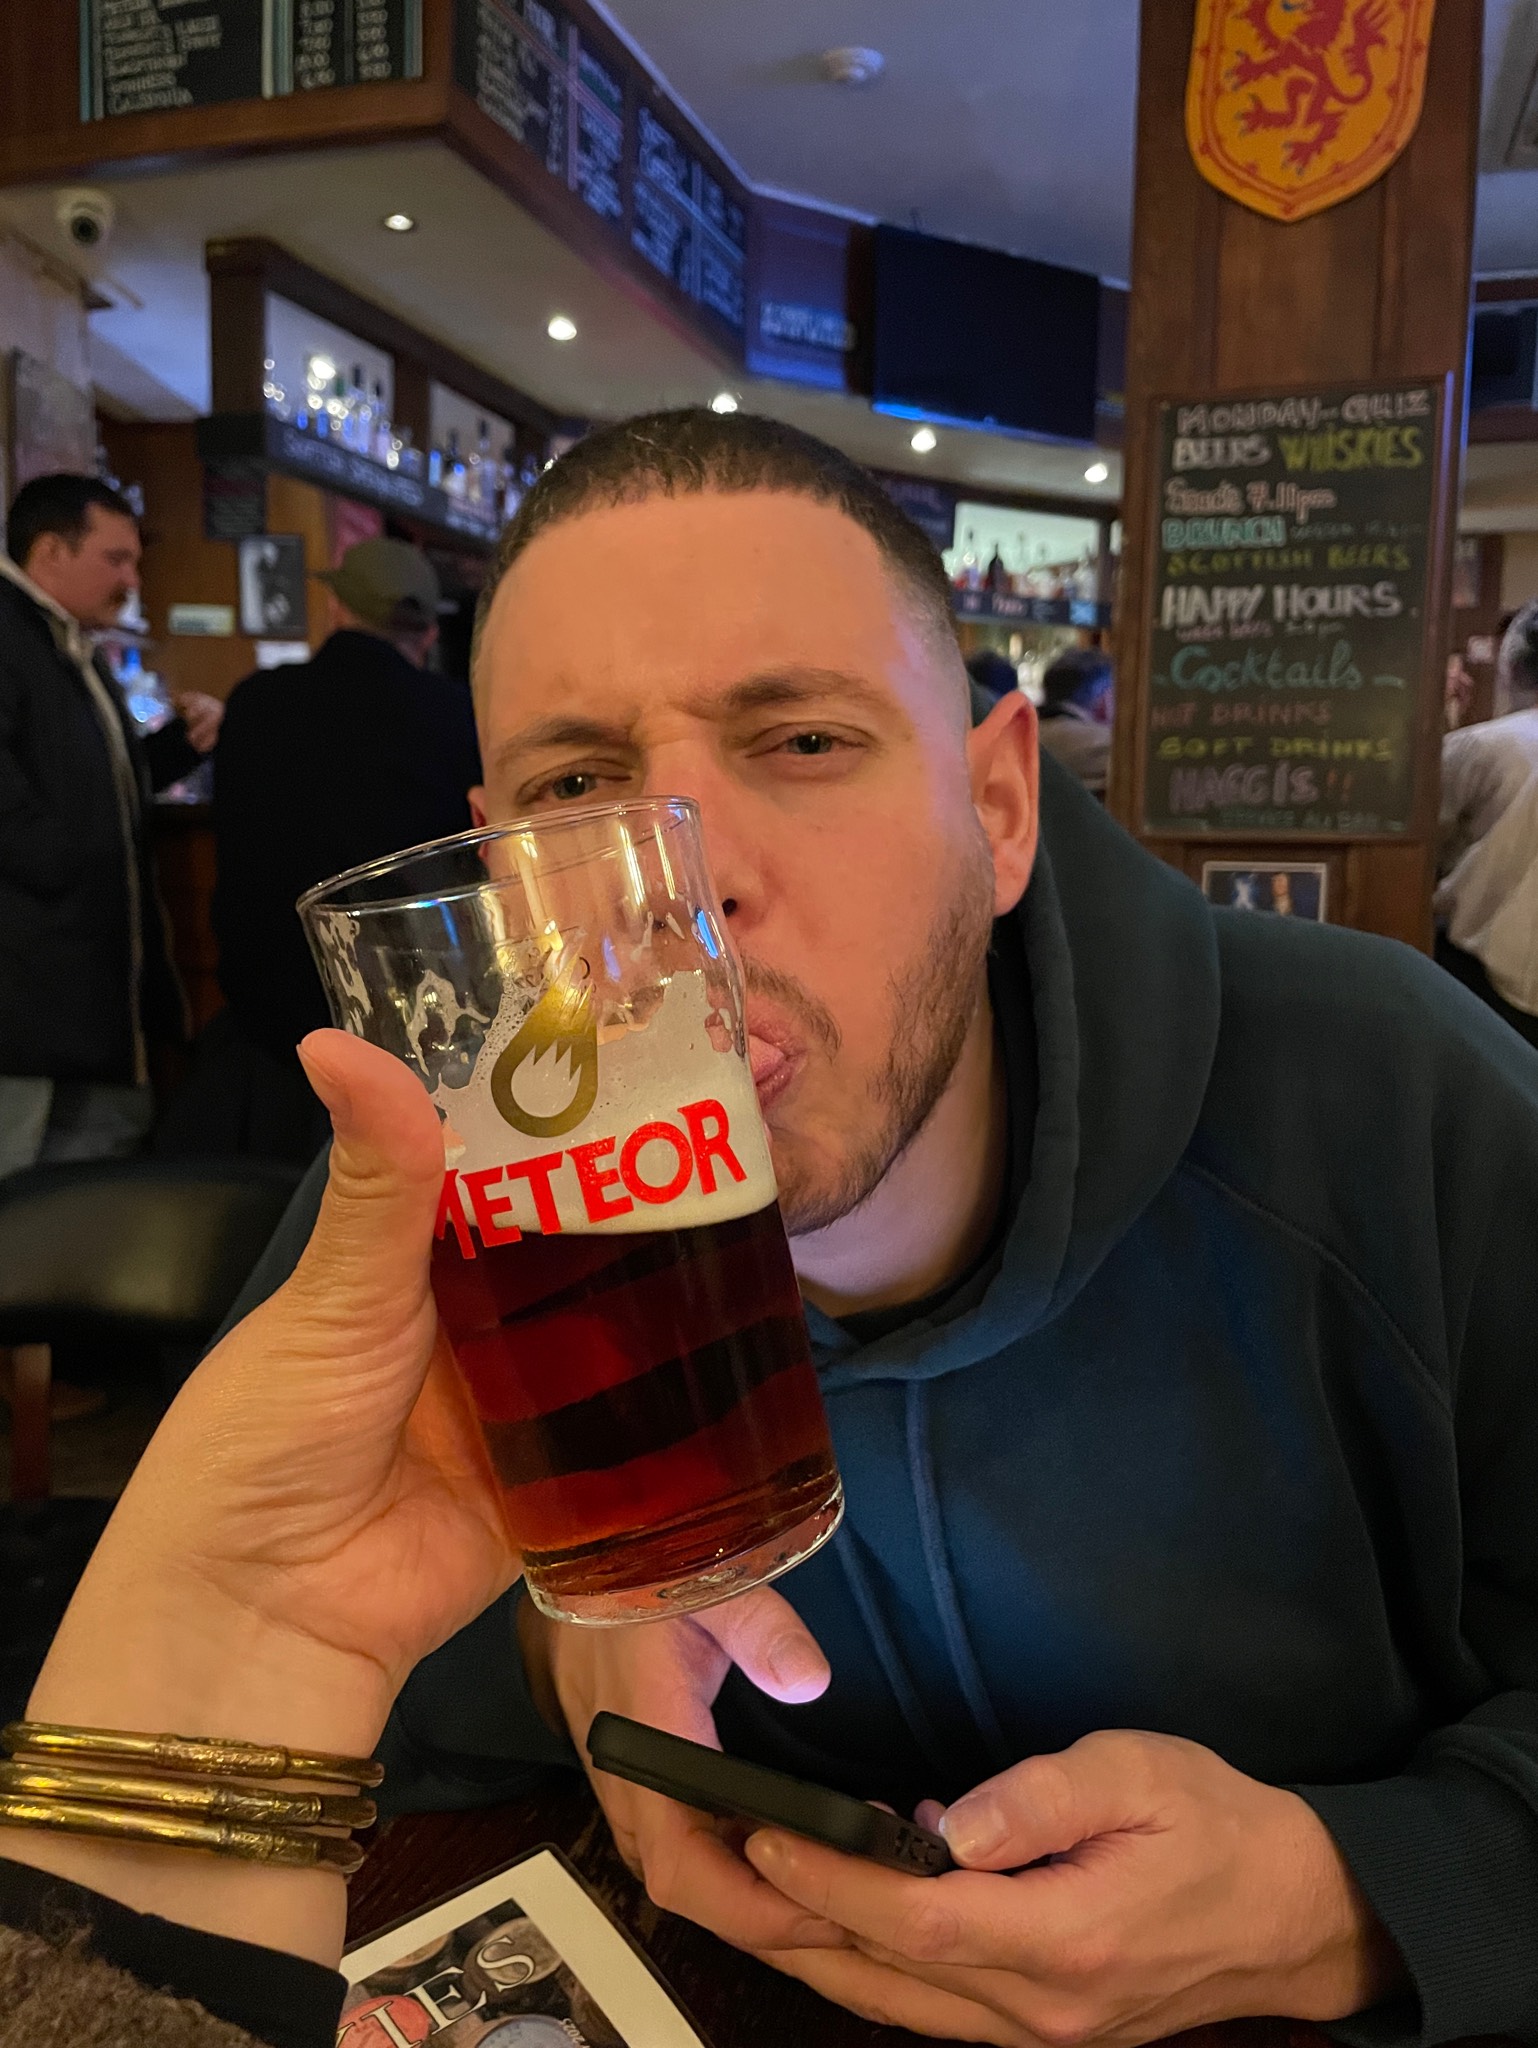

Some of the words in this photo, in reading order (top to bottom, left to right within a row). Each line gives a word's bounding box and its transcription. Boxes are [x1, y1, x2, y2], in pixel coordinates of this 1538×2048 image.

[1161, 515, 1287, 551] BRUNCH
[1161, 583, 1267, 630] HAPPY
[1272, 580, 1402, 623] HOURS
[1170, 638, 1363, 693] Cocktails
